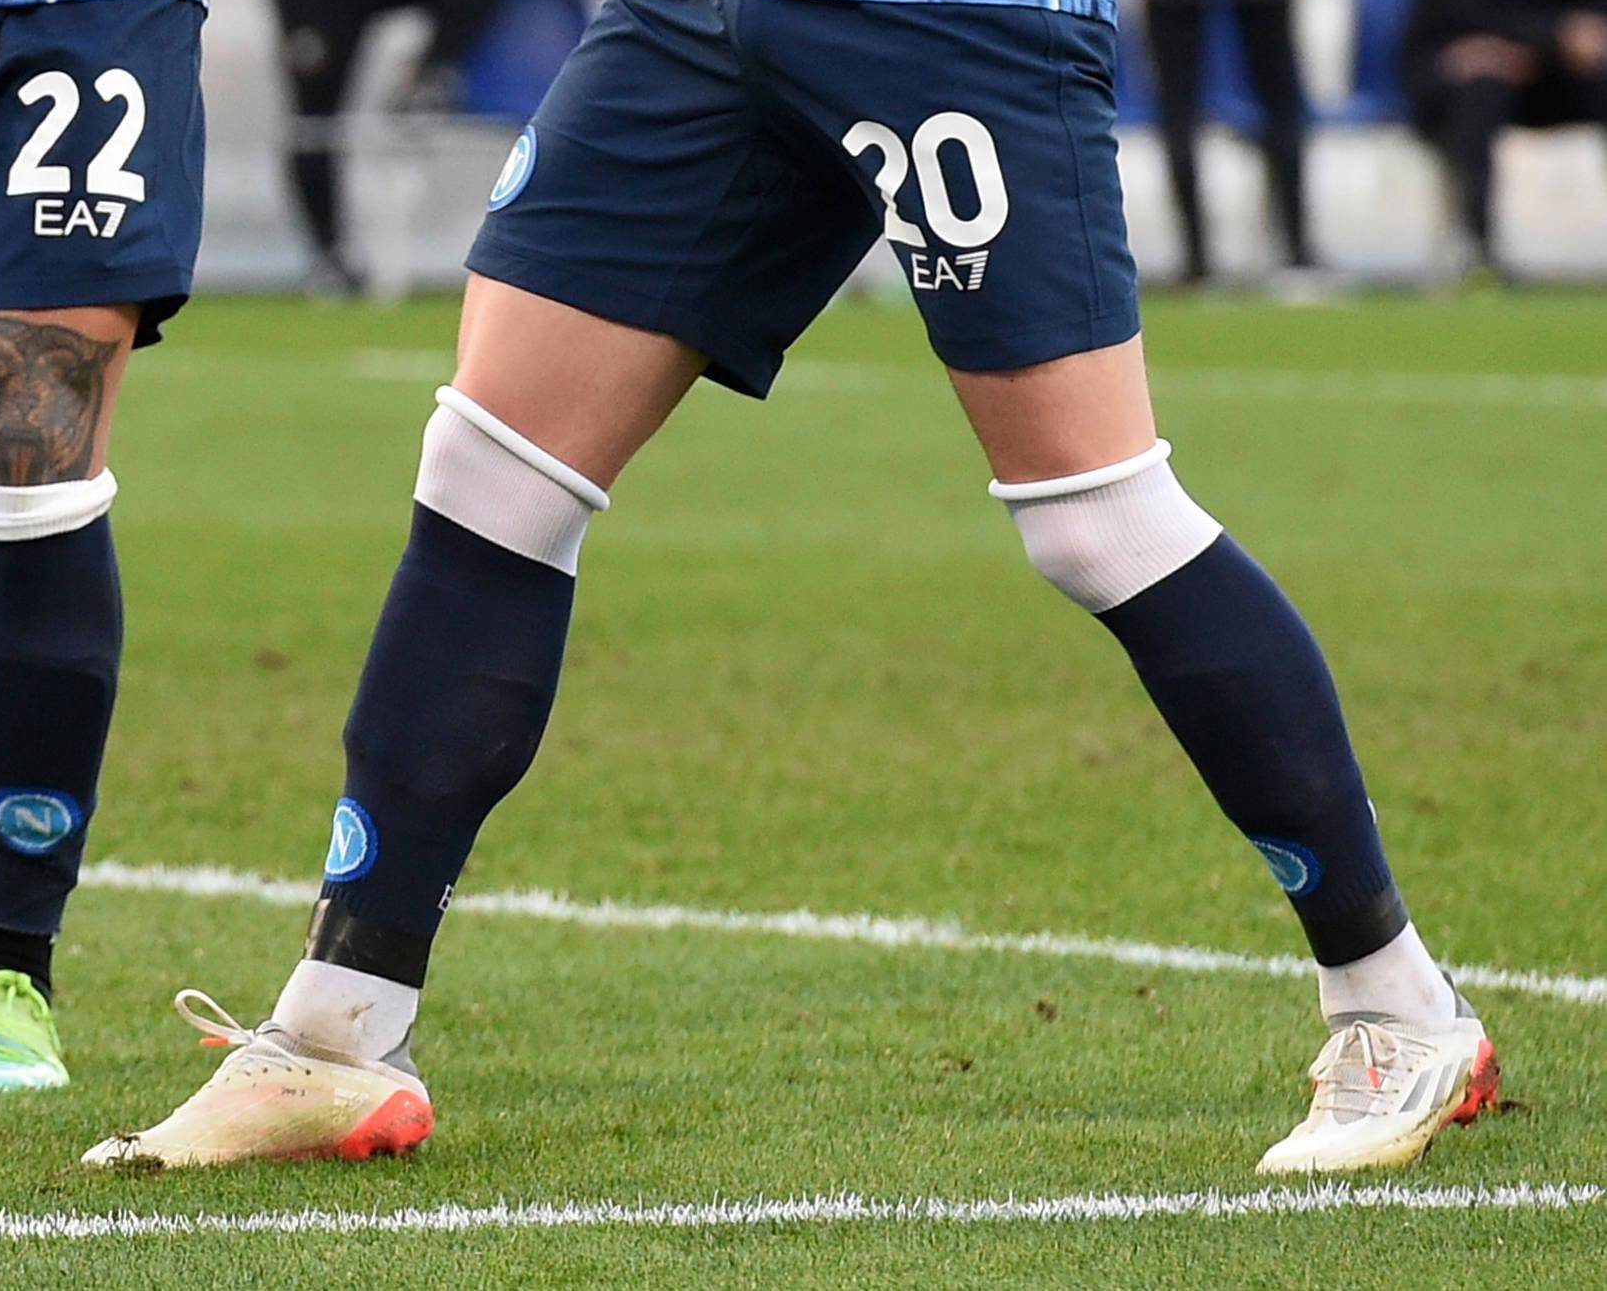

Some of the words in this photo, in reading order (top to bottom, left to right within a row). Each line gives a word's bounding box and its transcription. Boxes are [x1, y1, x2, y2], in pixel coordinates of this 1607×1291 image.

[5, 67, 147, 204] 22
[841, 111, 1010, 249] 20
[34, 198, 127, 239] EA7
[910, 249, 990, 291] EA7
